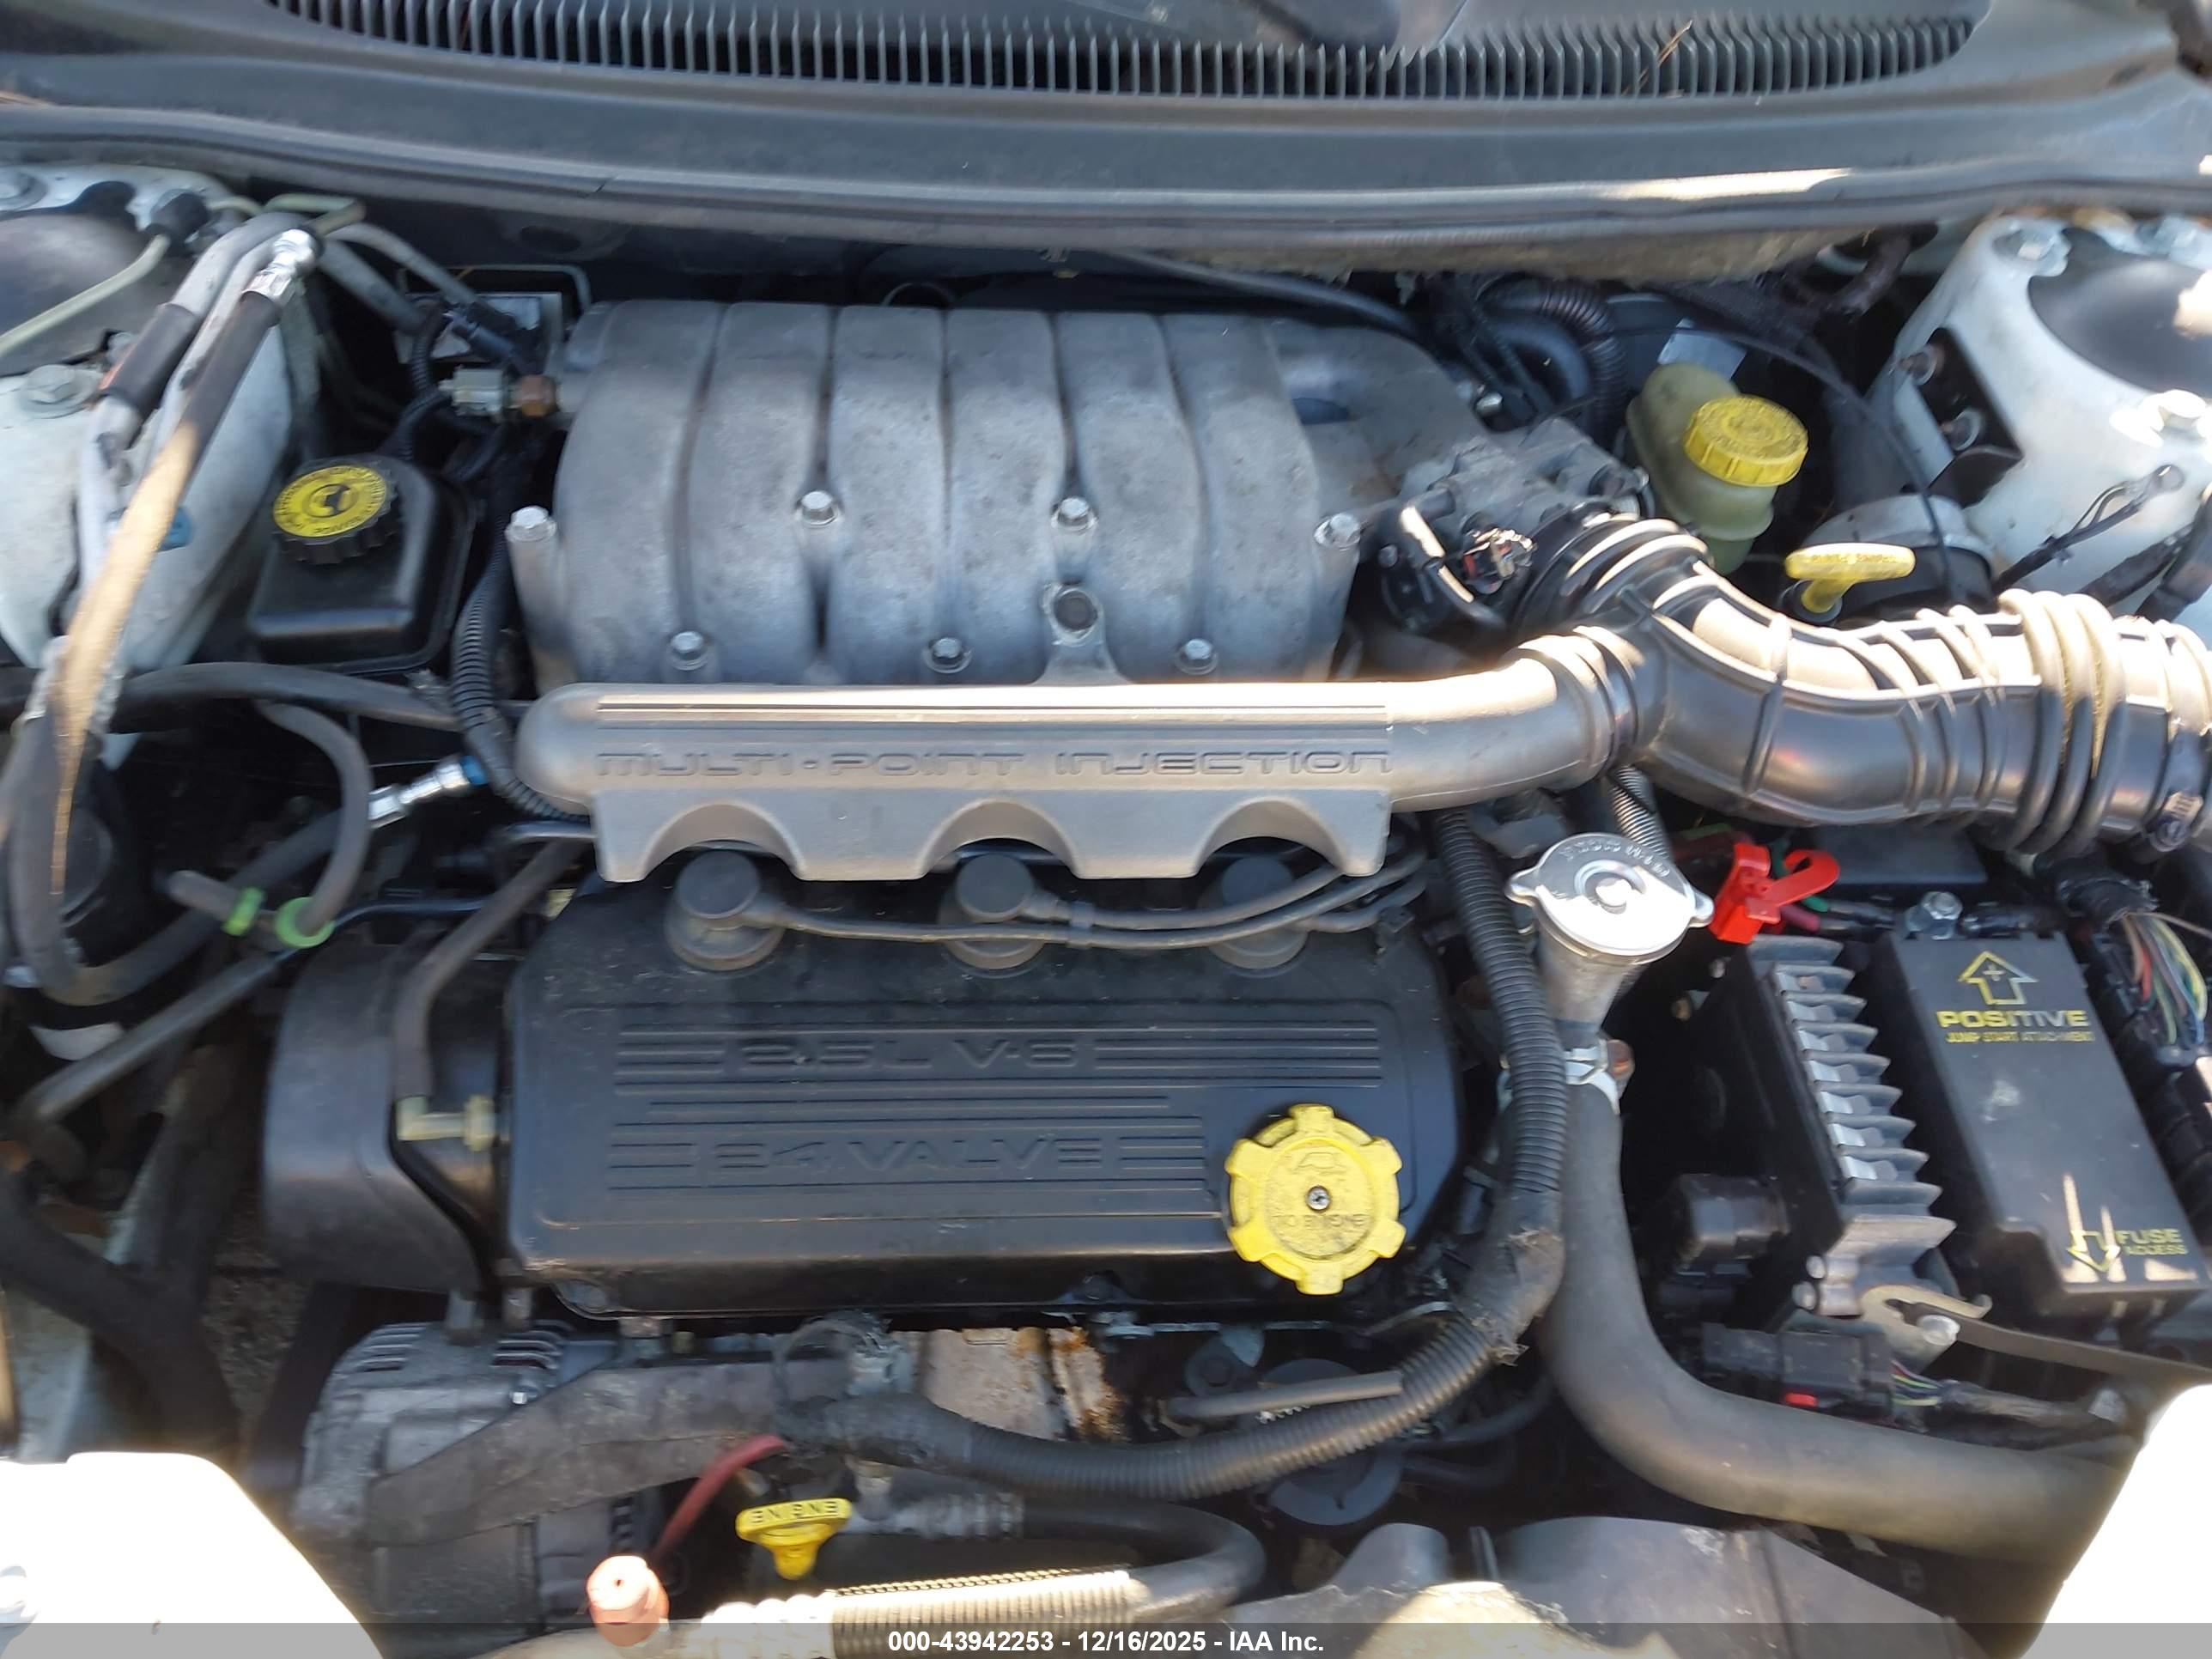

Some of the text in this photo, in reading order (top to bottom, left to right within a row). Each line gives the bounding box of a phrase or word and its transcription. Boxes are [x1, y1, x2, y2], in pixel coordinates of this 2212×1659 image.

[1057, 750, 1391, 775] INJECTION
[1936, 1011, 2089, 1027] POSITIVE
[2115, 1229, 2183, 1243] FUSE
